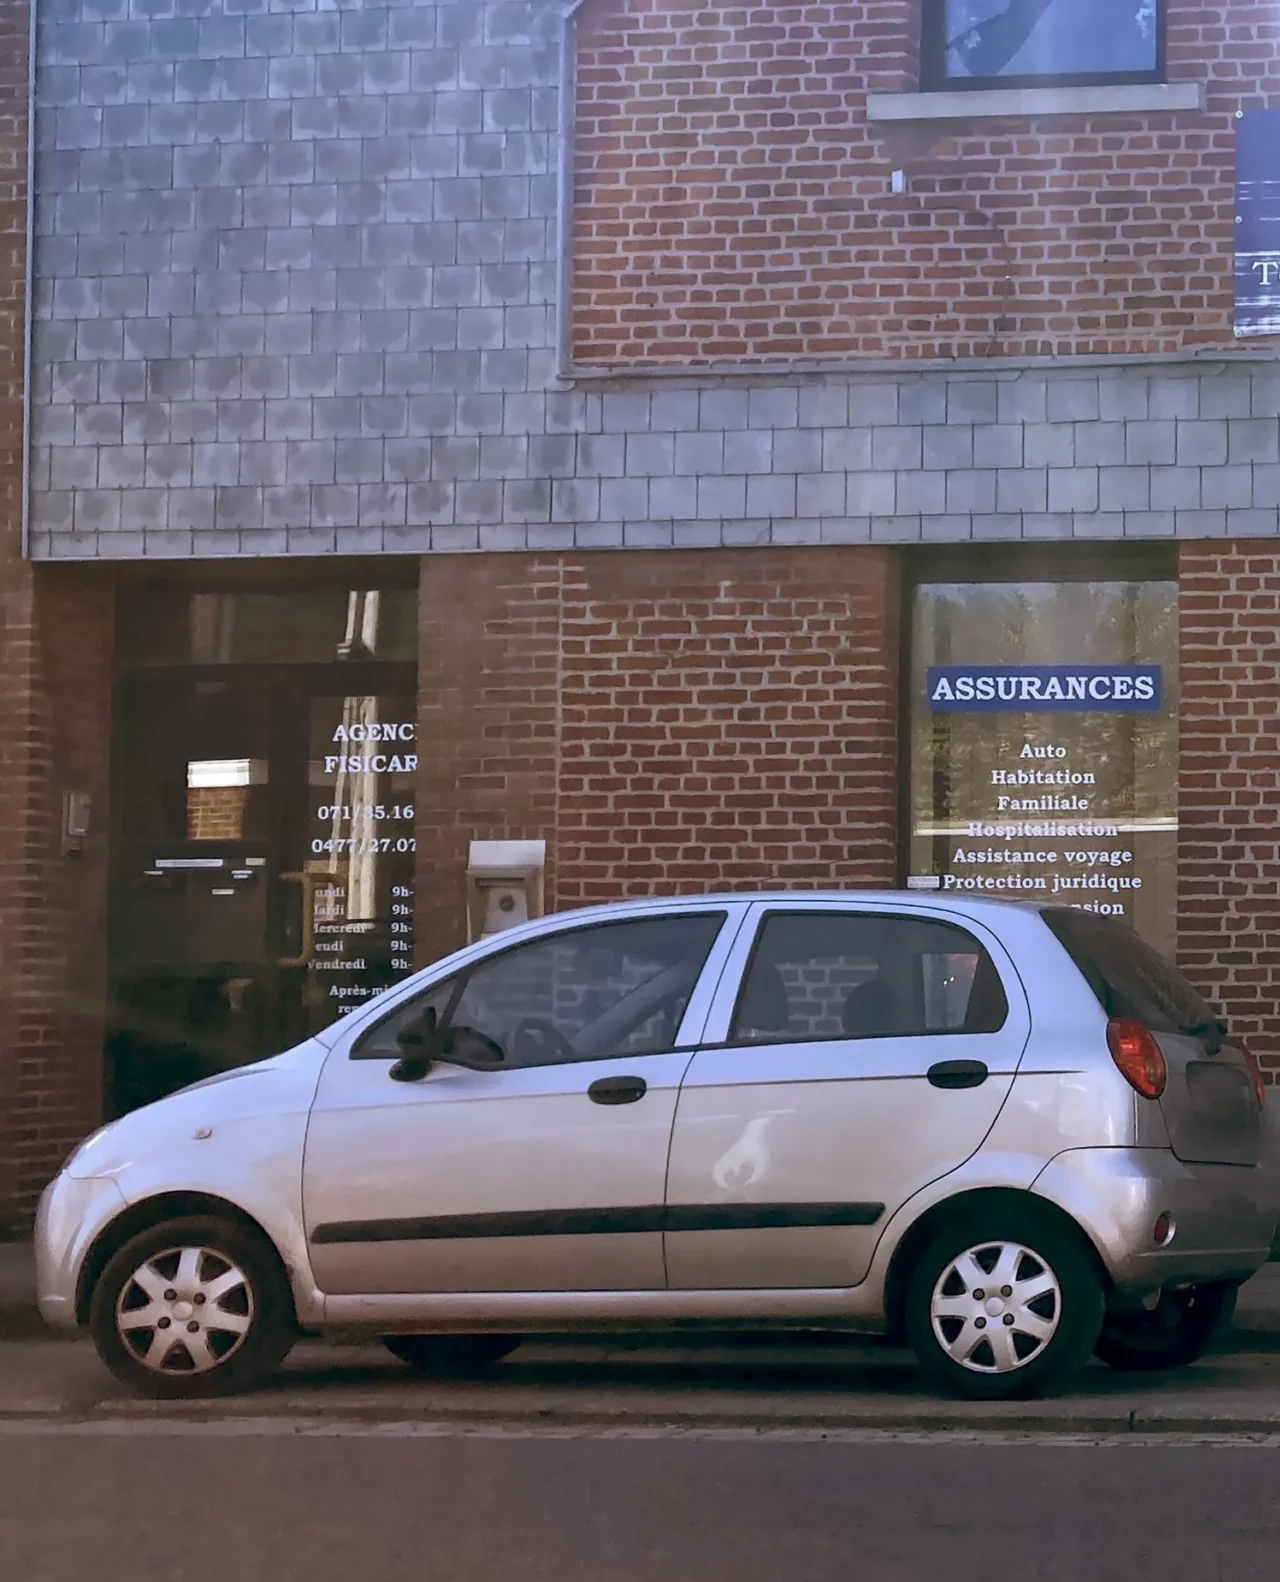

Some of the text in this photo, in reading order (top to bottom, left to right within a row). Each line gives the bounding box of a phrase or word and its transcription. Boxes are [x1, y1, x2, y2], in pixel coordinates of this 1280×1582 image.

[931, 675, 1155, 701] ASSURANCES
[332, 723, 419, 742] AGENC
[1019, 743, 1068, 759] Auto
[990, 769, 1096, 785] Habitation
[996, 795, 1090, 811] Familiale
[967, 820, 1119, 841] Hospitalisation
[952, 847, 1133, 867] Assistance voyage
[943, 873, 1047, 889] Protection
[1051, 873, 1143, 893] juridique
[314, 886, 346, 898] undi
[1069, 899, 1125, 916] sion
[314, 939, 344, 952] eudi
